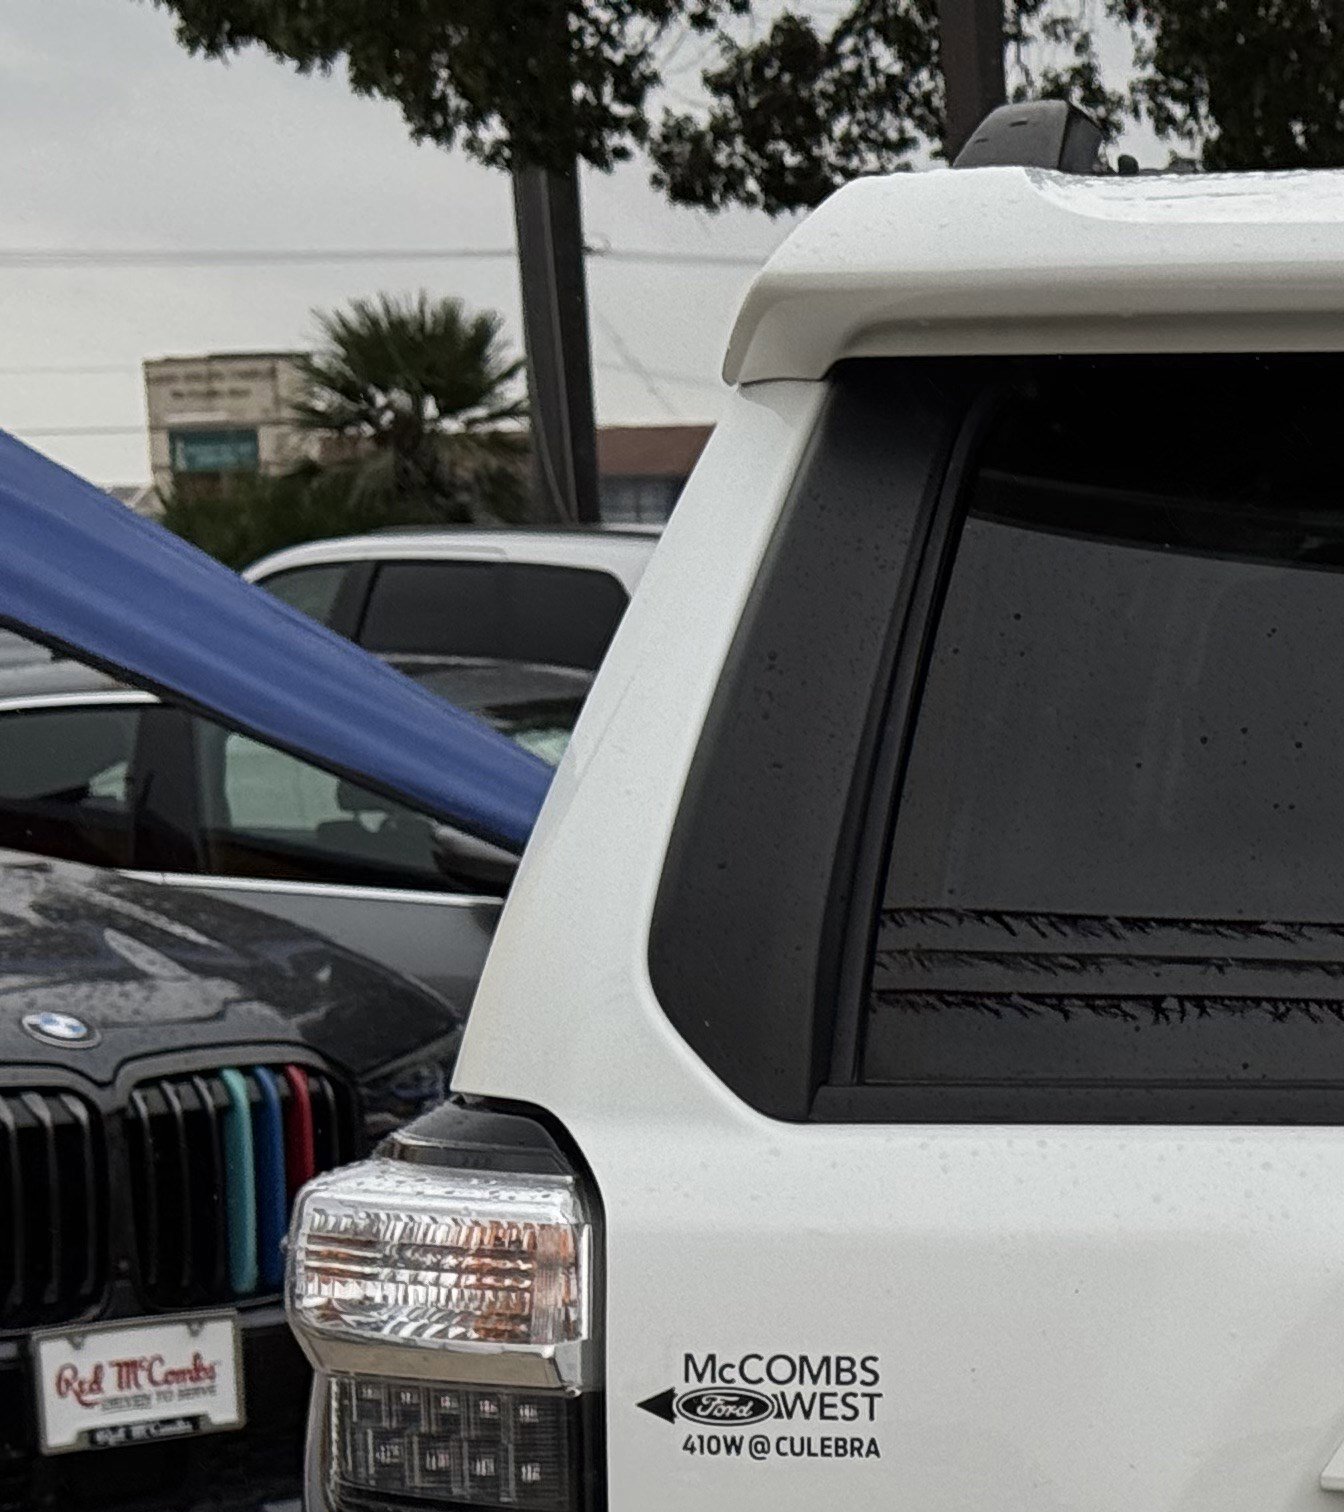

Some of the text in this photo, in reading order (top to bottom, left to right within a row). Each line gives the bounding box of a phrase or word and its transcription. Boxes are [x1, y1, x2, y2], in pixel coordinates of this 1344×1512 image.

[683, 1353, 880, 1386] McCOMBS
[56, 1362, 105, 1409] Red
[695, 1395, 753, 1418] Ford
[780, 1391, 883, 1421] WEST
[682, 1434, 744, 1456] 410W
[775, 1436, 881, 1458] CULEBRA
